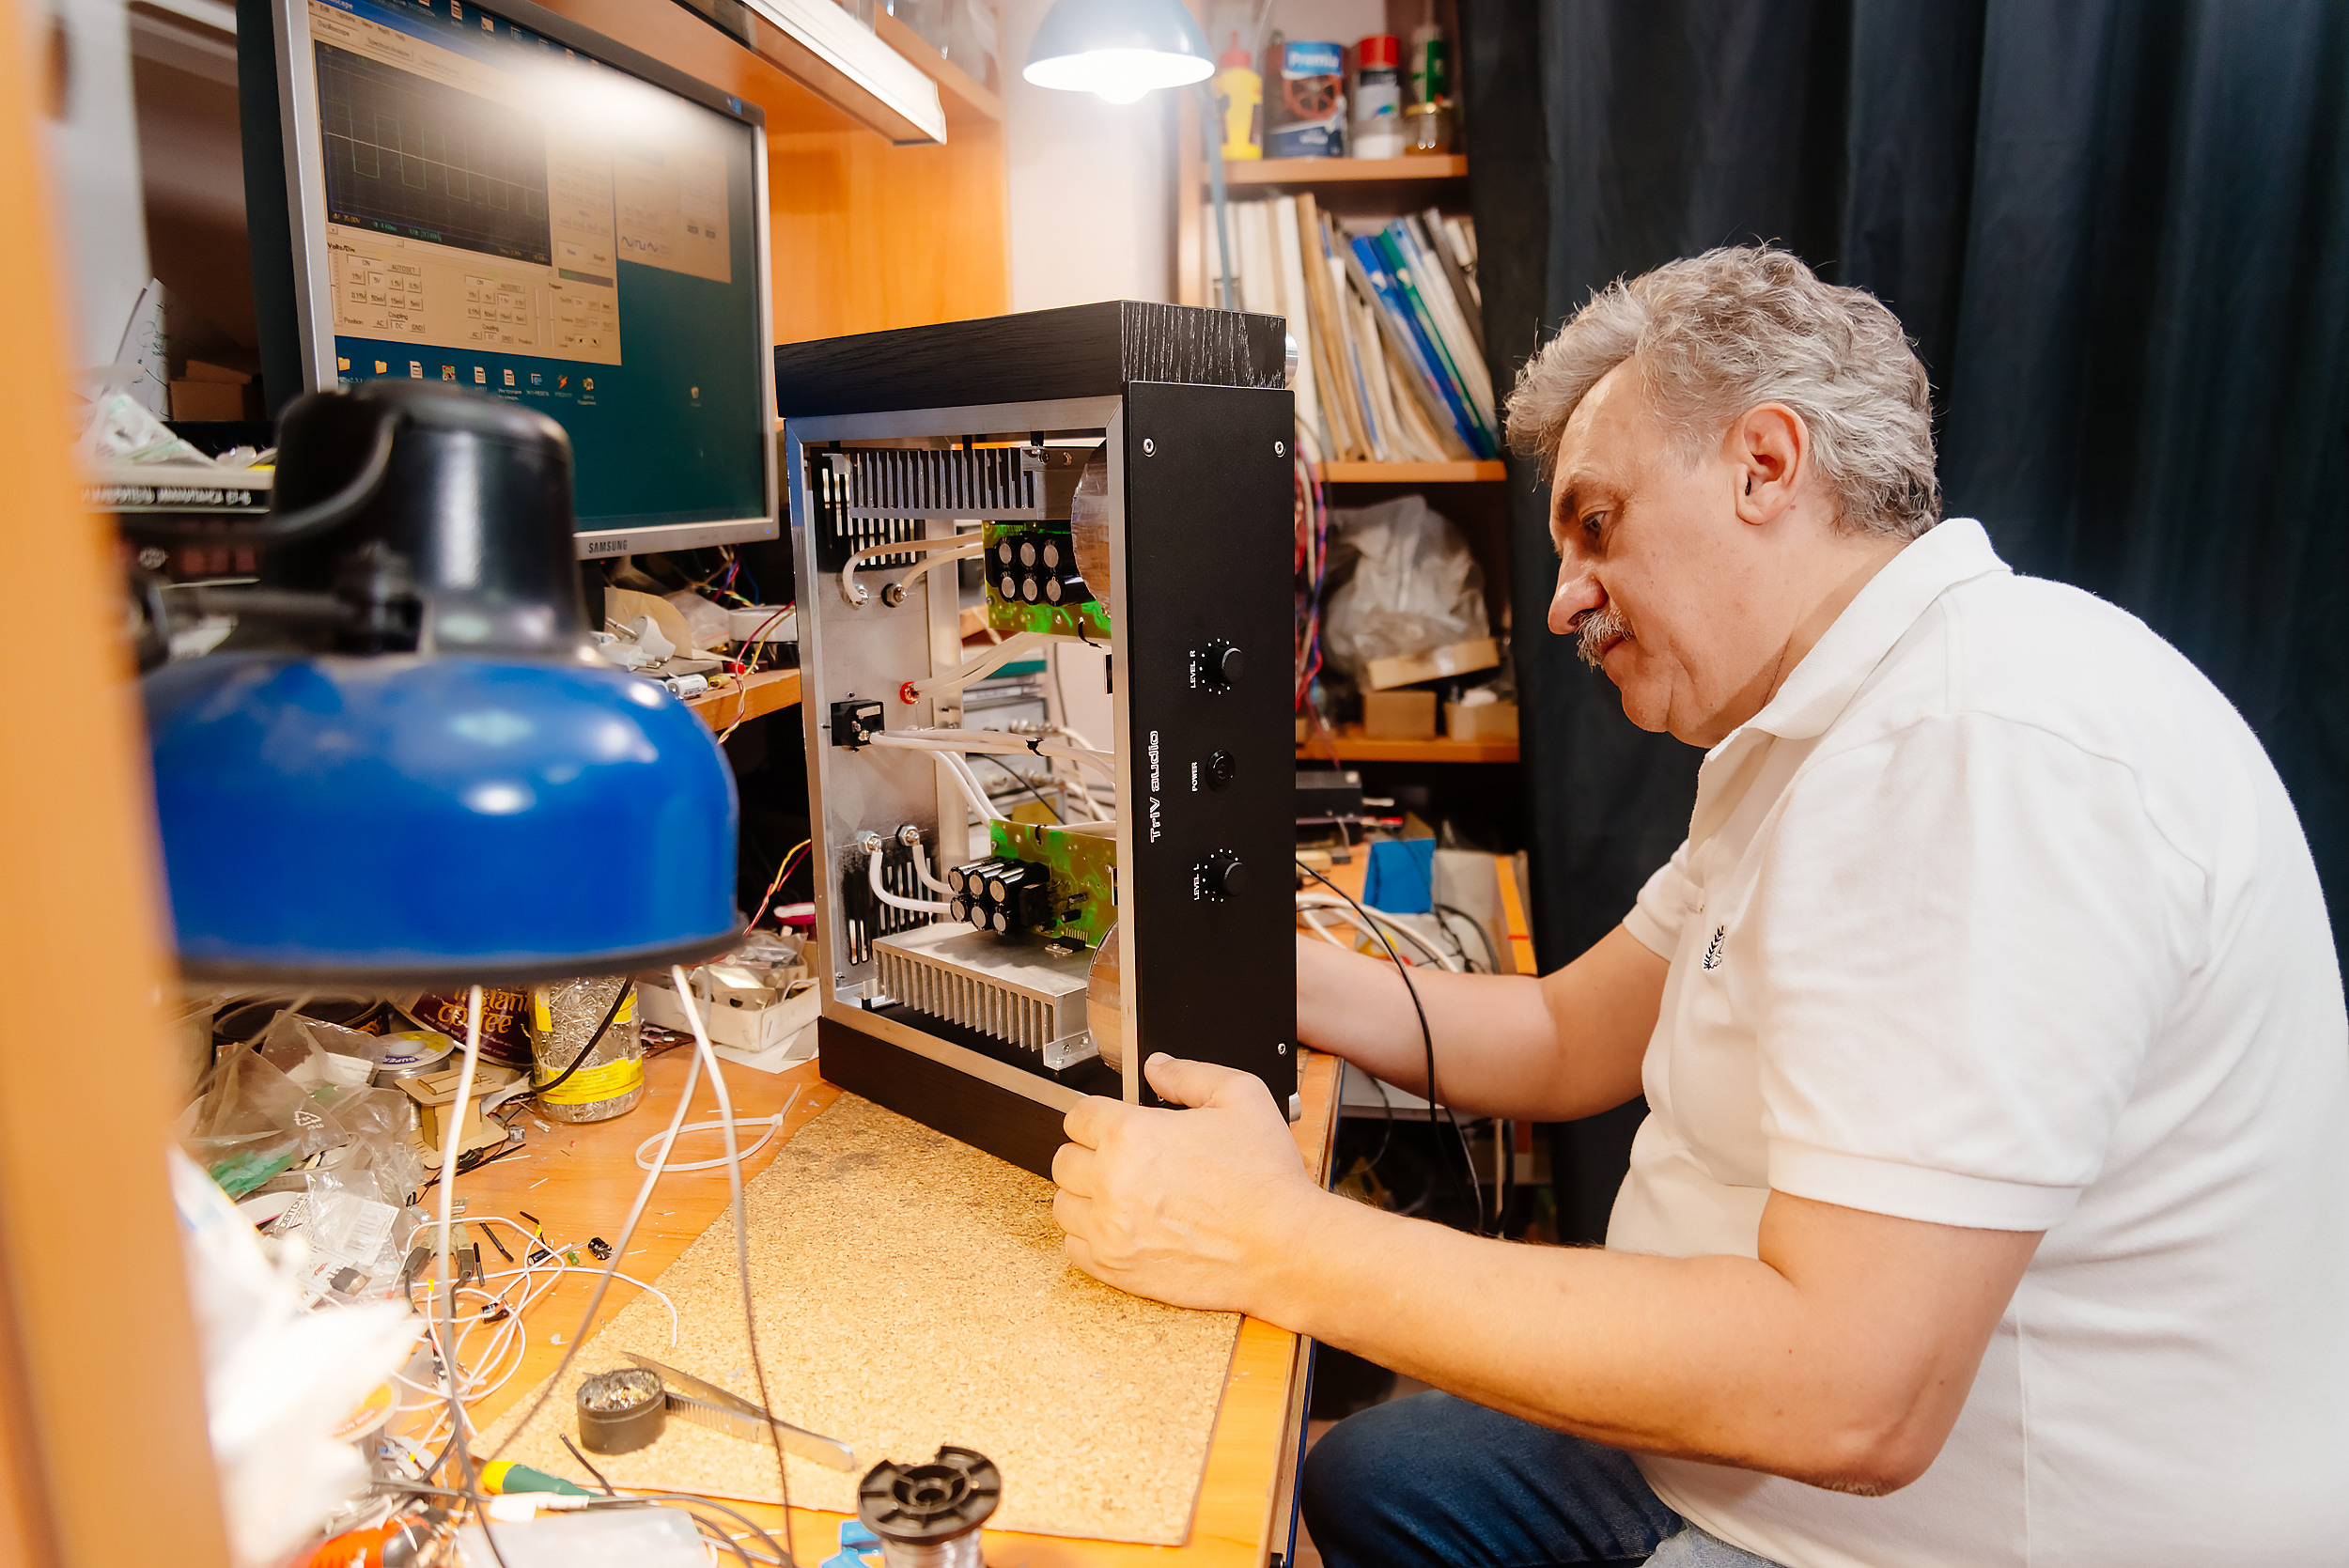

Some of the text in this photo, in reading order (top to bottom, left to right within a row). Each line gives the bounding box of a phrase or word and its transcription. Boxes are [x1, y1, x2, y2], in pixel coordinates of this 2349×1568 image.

[318, 20, 350, 37] Oscilloscope
[391, 264, 416, 274] AUTOSET
[388, 311, 409, 320] Coupling
[588, 539, 629, 553] SAMSUNG
[1190, 649, 1196, 658] R
[1148, 730, 1160, 792] audio
[1193, 862, 1200, 871] L
[438, 1001, 514, 1033] cofee
